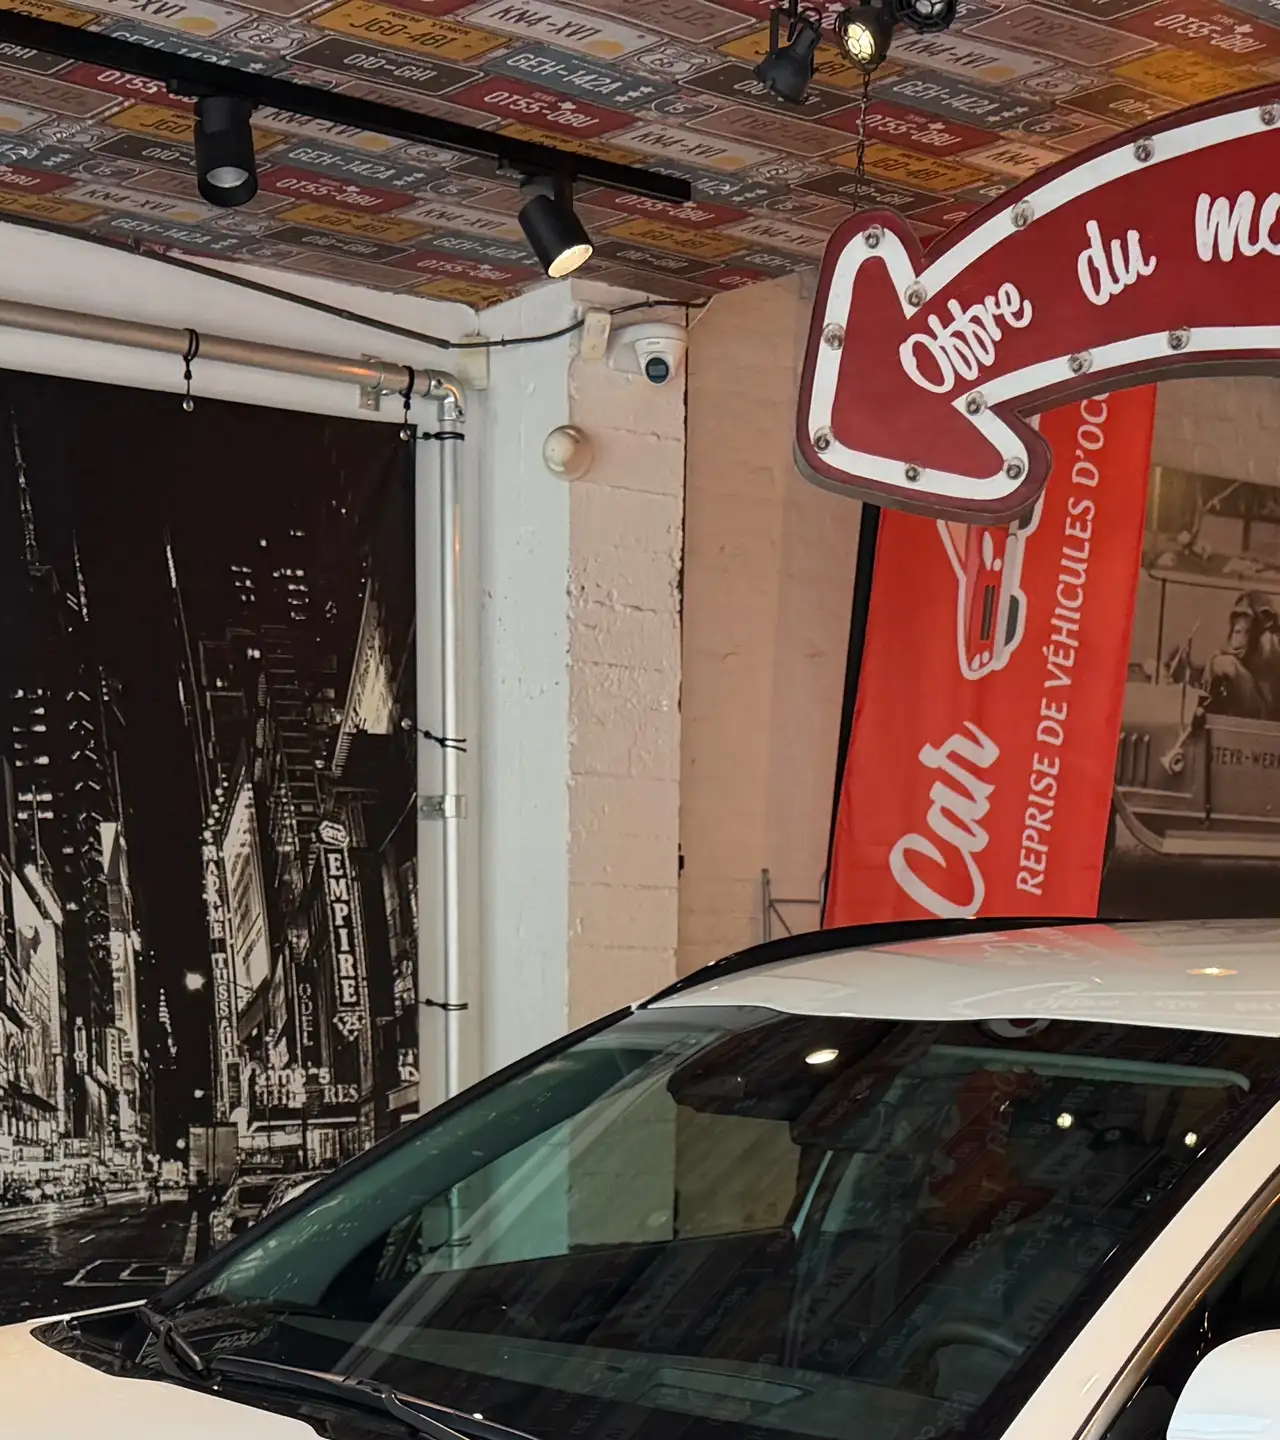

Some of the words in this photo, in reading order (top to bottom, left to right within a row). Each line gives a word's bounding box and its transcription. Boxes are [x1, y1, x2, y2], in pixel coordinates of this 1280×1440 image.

[505, 53, 623, 97] GEH-142A
[897, 280, 1034, 395] Offre
[1076, 218, 1158, 306] du
[1040, 495, 1097, 691] VÉHICULES
[1037, 696, 1069, 748] DE
[887, 719, 1002, 919] Car
[1016, 750, 1062, 897] REPRISE
[325, 850, 360, 1005] EMPIRE
